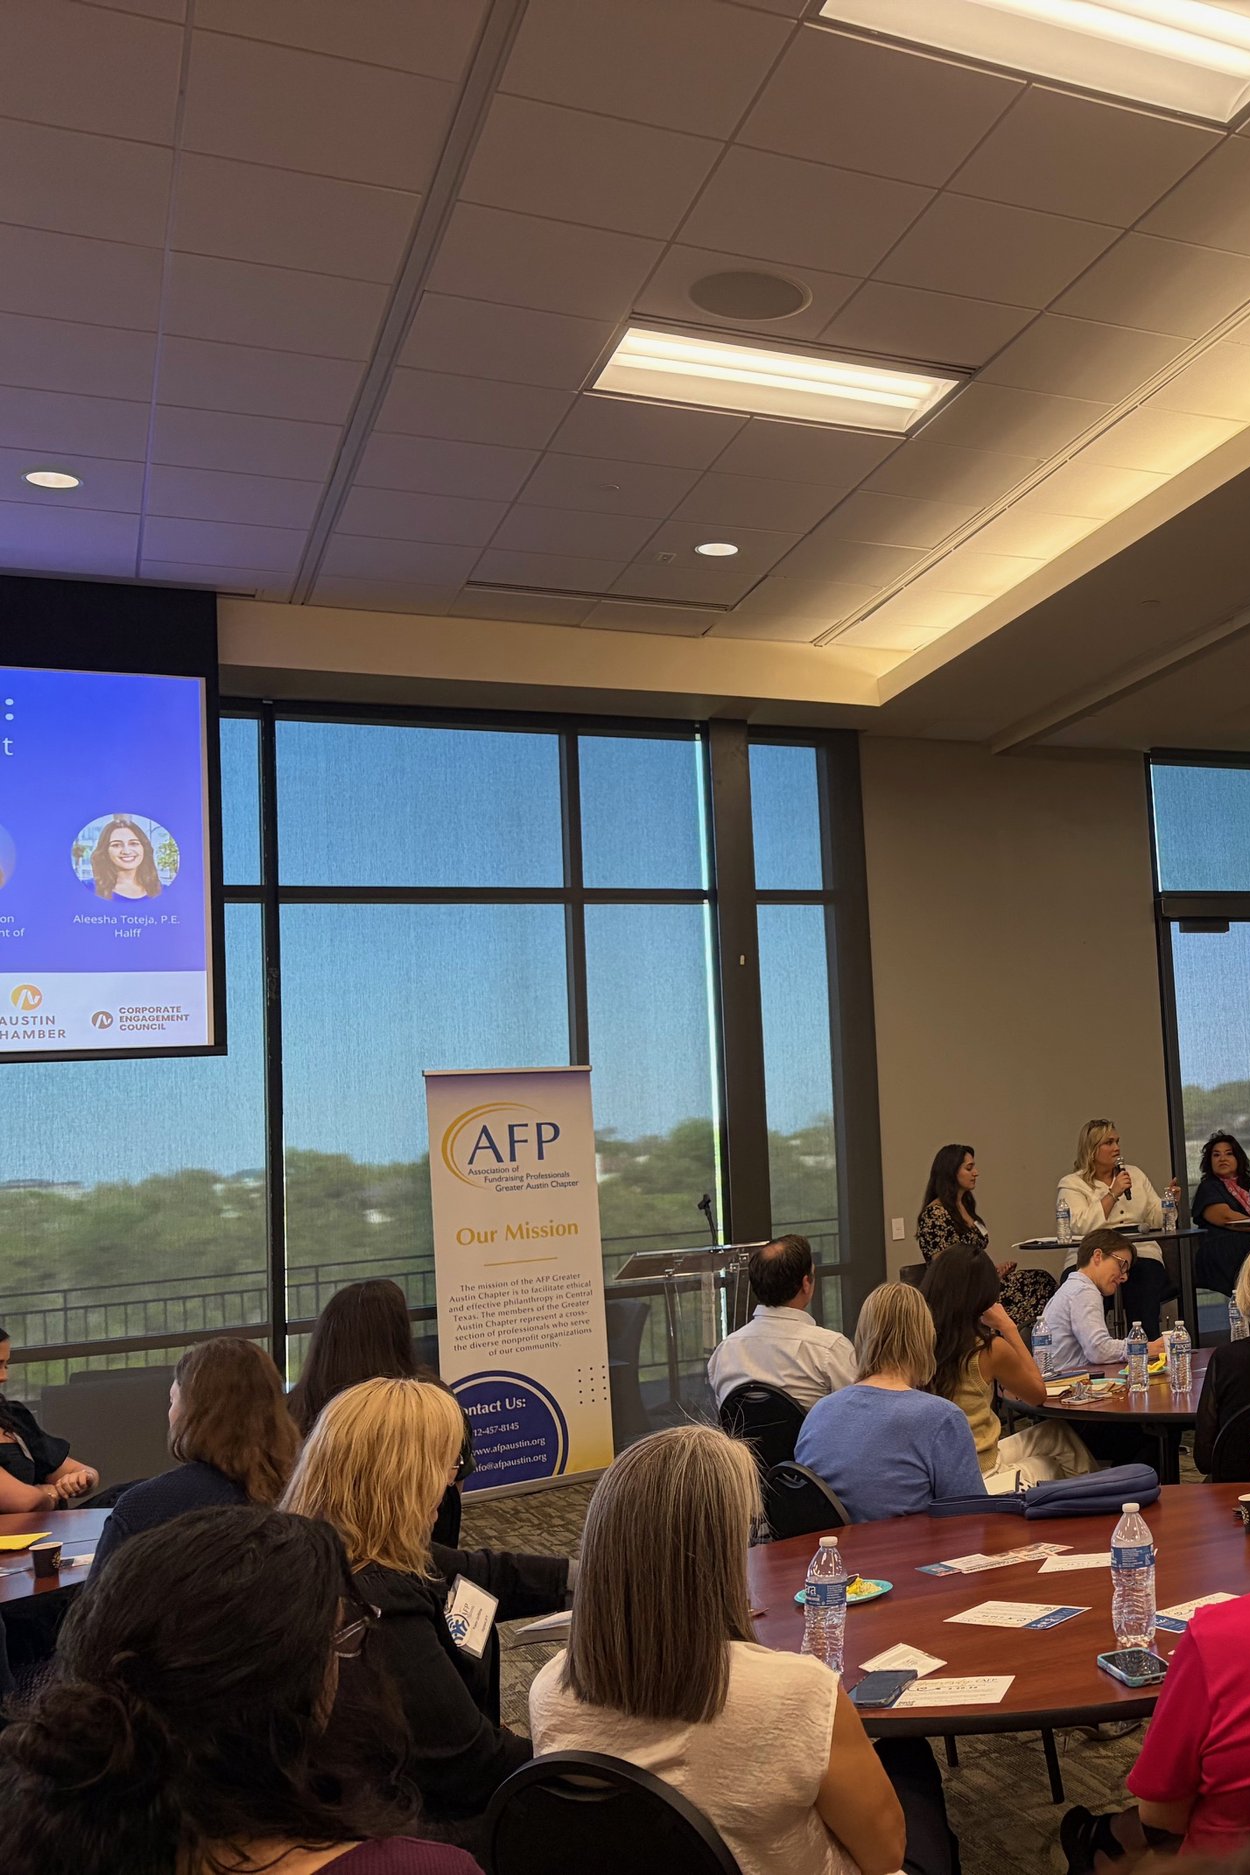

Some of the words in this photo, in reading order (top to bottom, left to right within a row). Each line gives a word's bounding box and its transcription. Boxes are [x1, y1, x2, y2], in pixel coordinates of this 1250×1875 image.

[73, 915, 118, 925] Aleesha
[122, 915, 158, 927] Toteja,
[161, 915, 181, 924] P.E.
[13, 928, 25, 938] of
[115, 928, 142, 938] Halff
[119, 1006, 182, 1014] CORPORATE
[0, 1015, 56, 1026] AUSTIN
[119, 1014, 190, 1022] ENGAGEMENT
[0, 1029, 66, 1040] HAMBER
[119, 1023, 166, 1031] COUNCIL
[467, 1121, 561, 1165] AFP
[468, 1167, 510, 1176] Association
[511, 1165, 520, 1173] of
[484, 1174, 524, 1184] Fundraising
[526, 1171, 570, 1180] Professionals
[495, 1183, 524, 1192] Greater
[526, 1181, 549, 1190] Austin
[550, 1180, 579, 1189] Chapter
[456, 1227, 498, 1246] Our
[505, 1219, 579, 1241] Mission
[460, 1284, 476, 1292] The
[478, 1281, 508, 1290] mission
[510, 1279, 519, 1287] of
[521, 1277, 534, 1285] the
[536, 1275, 550, 1283] AFP
[552, 1273, 581, 1282] Greater
[449, 1294, 476, 1303] Austin
[478, 1291, 510, 1300] Chapter
[531, 1284, 565, 1294] facilitate
[566, 1280, 591, 1289] ethical
[449, 1305, 464, 1313] and
[466, 1302, 501, 1311] effective
[503, 1295, 554, 1308] philanthropy
[565, 1289, 593, 1299] Central
[481, 1311, 496, 1319] The
[498, 1307, 534, 1317] members
[546, 1303, 560, 1311] the
[561, 1300, 590, 1309] Greater
[456, 1322, 483, 1331] Austin
[485, 1318, 517, 1328] Chapter
[519, 1313, 557, 1324] represent
[565, 1310, 589, 1318] cross-
[455, 1332, 485, 1341] section
[487, 1330, 496, 1338] of
[497, 1323, 550, 1338] professionals
[552, 1321, 569, 1329] who
[570, 1319, 591, 1327] serve
[453, 1344, 468, 1352] the
[469, 1340, 499, 1350] diverse
[501, 1334, 539, 1345] nonprofit
[540, 1328, 592, 1340] organizations
[488, 1349, 497, 1357] of
[499, 1347, 513, 1355] our
[515, 1341, 562, 1353] community.
[463, 1400, 501, 1416] ontact
[505, 1397, 526, 1410] Us:
[473, 1422, 520, 1437] 12-457-8145
[473, 1454, 547, 1473] nfo@afpaustin.org
